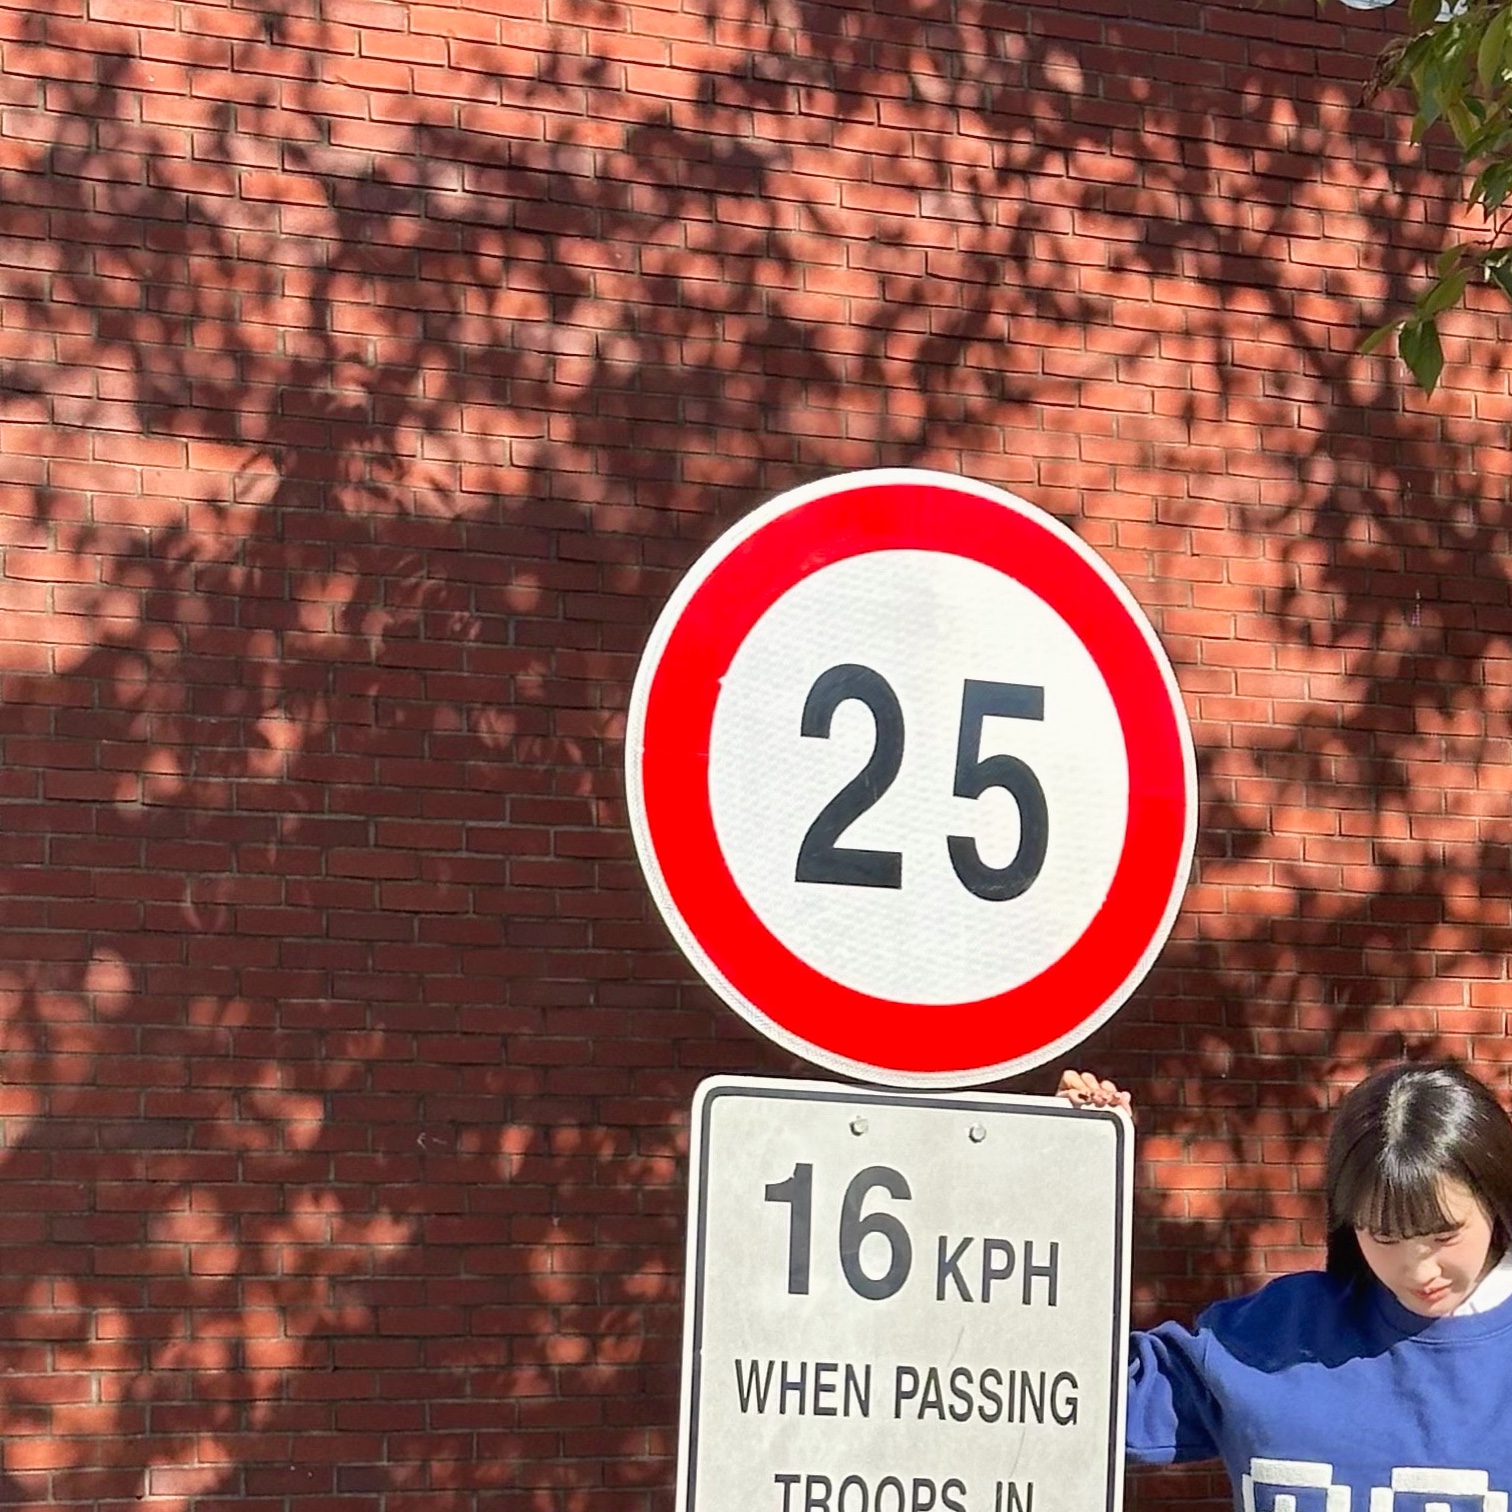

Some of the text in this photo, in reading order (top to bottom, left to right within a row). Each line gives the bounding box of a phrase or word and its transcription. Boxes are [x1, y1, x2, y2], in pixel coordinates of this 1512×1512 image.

[795, 663, 1049, 901] 25
[764, 1163, 1059, 1306] 16 KPH
[734, 1360, 1078, 1425] WHEN PASSING
